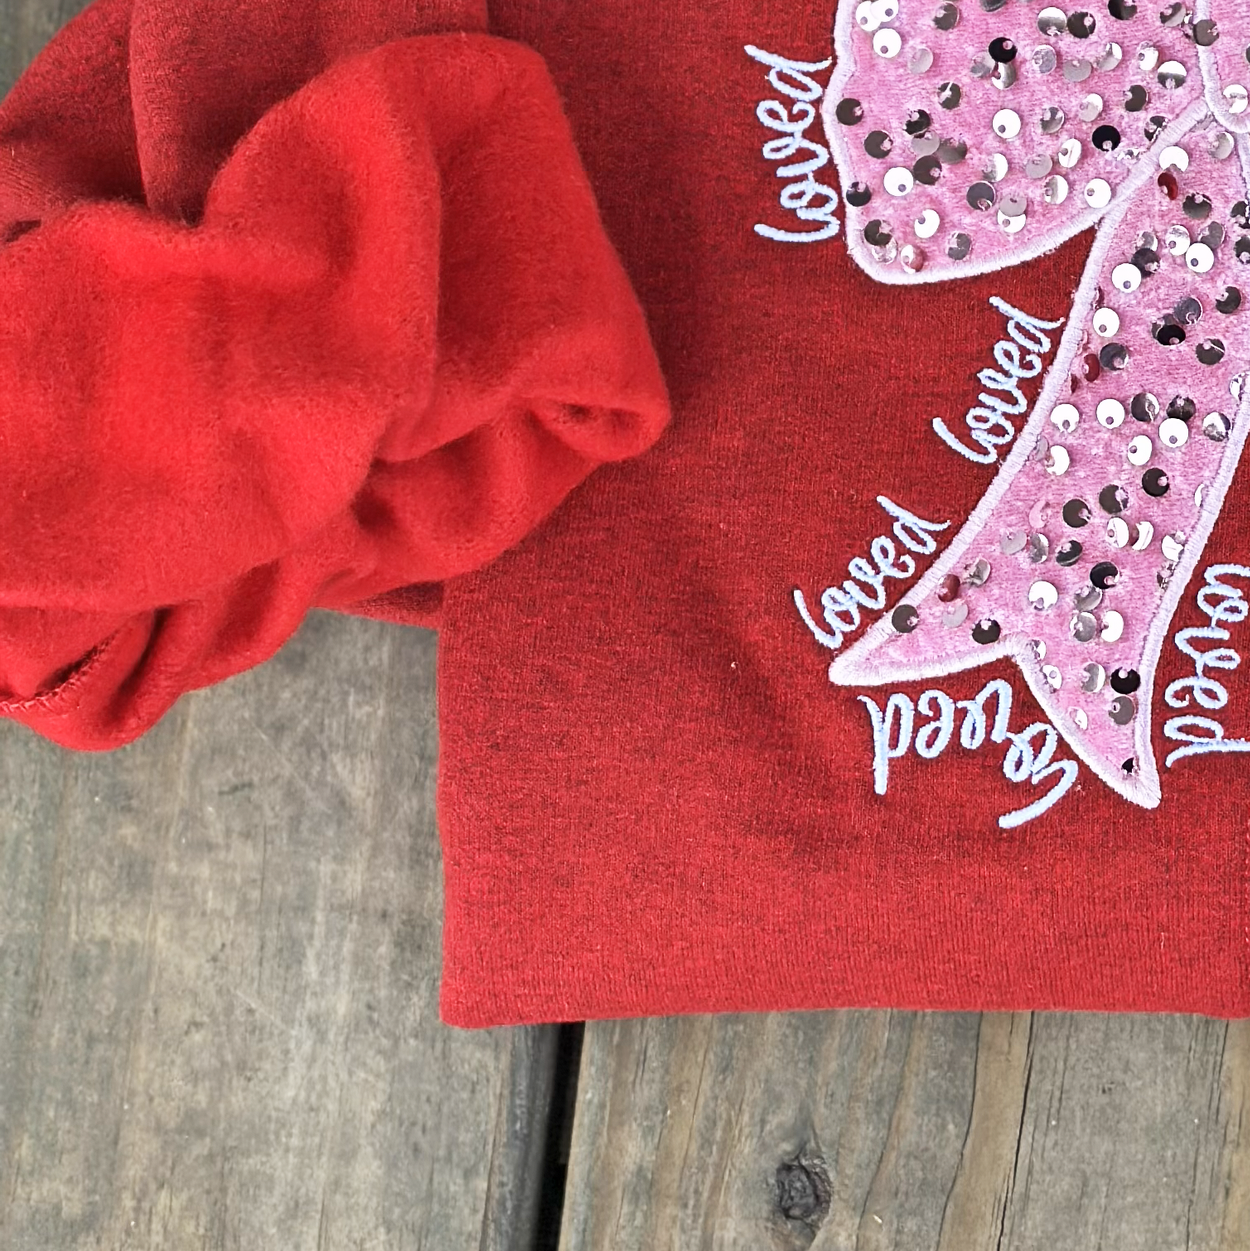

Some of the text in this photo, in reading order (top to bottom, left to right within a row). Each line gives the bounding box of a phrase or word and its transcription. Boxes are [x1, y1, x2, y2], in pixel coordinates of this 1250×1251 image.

[745, 44, 833, 243] loved
[932, 296, 1065, 465] loved
[793, 495, 952, 650] loved
